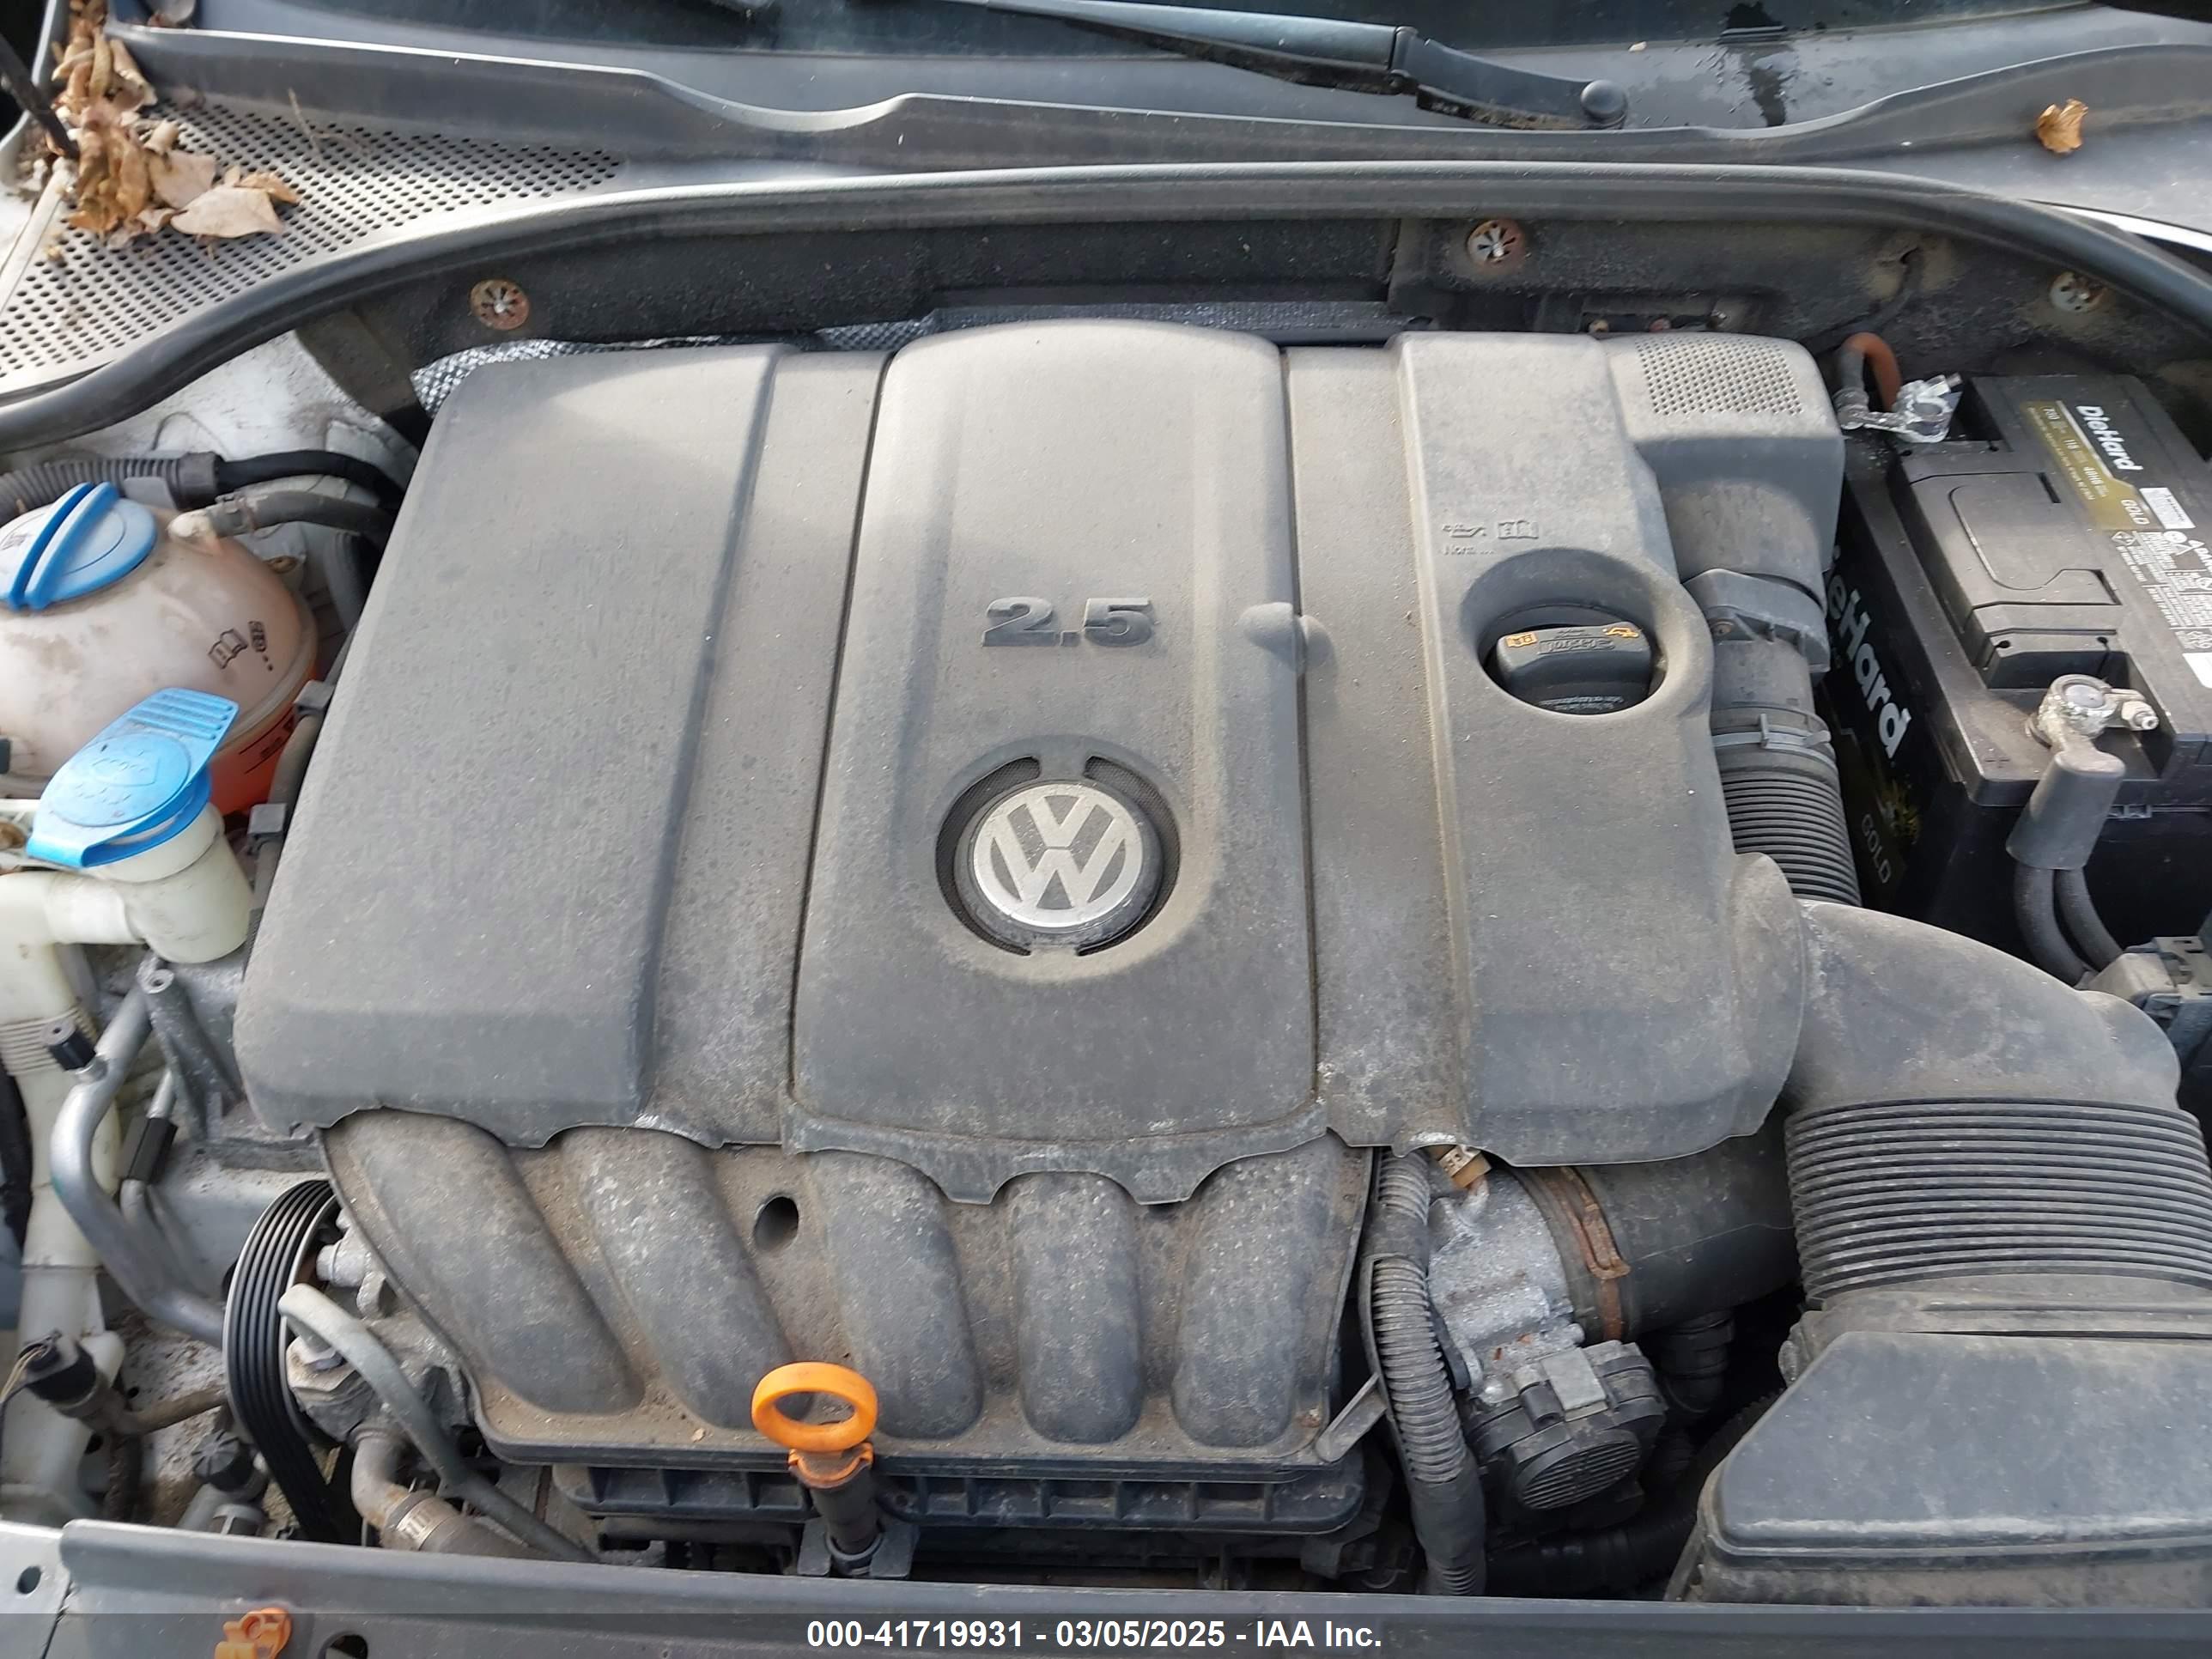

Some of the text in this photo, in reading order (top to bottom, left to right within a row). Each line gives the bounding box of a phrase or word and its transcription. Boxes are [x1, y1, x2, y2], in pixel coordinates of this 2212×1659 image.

[2075, 405, 2144, 471] DieHard
[2120, 499, 2150, 525] GOLD
[981, 596, 1156, 648] 2.5
[1862, 813, 1892, 884] GOLD
